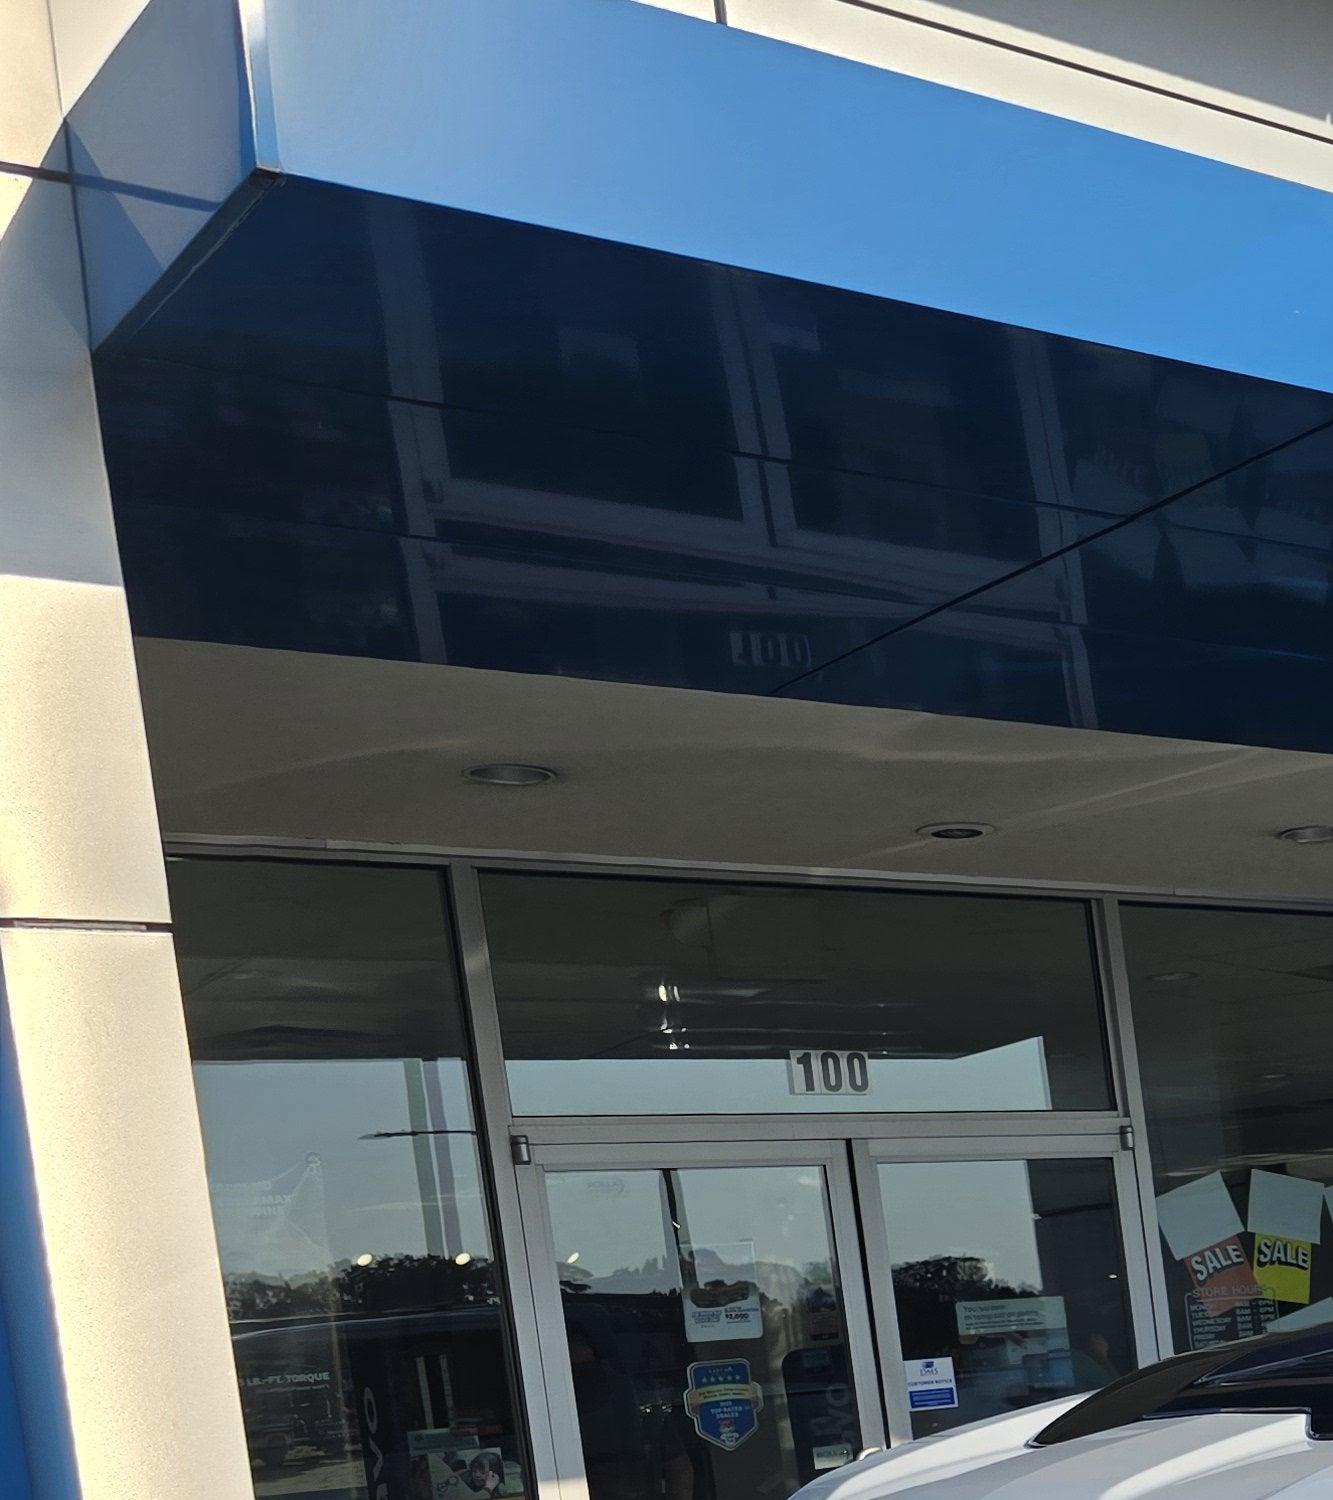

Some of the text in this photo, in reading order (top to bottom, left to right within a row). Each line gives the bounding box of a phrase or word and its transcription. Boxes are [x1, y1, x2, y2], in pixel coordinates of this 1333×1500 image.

[797, 1051, 869, 1093] 100
[1190, 1244, 1245, 1281] SALE
[1258, 1236, 1309, 1270] SALE
[1193, 1287, 1228, 1298] STORE
[286, 1371, 330, 1383] TORQUE
